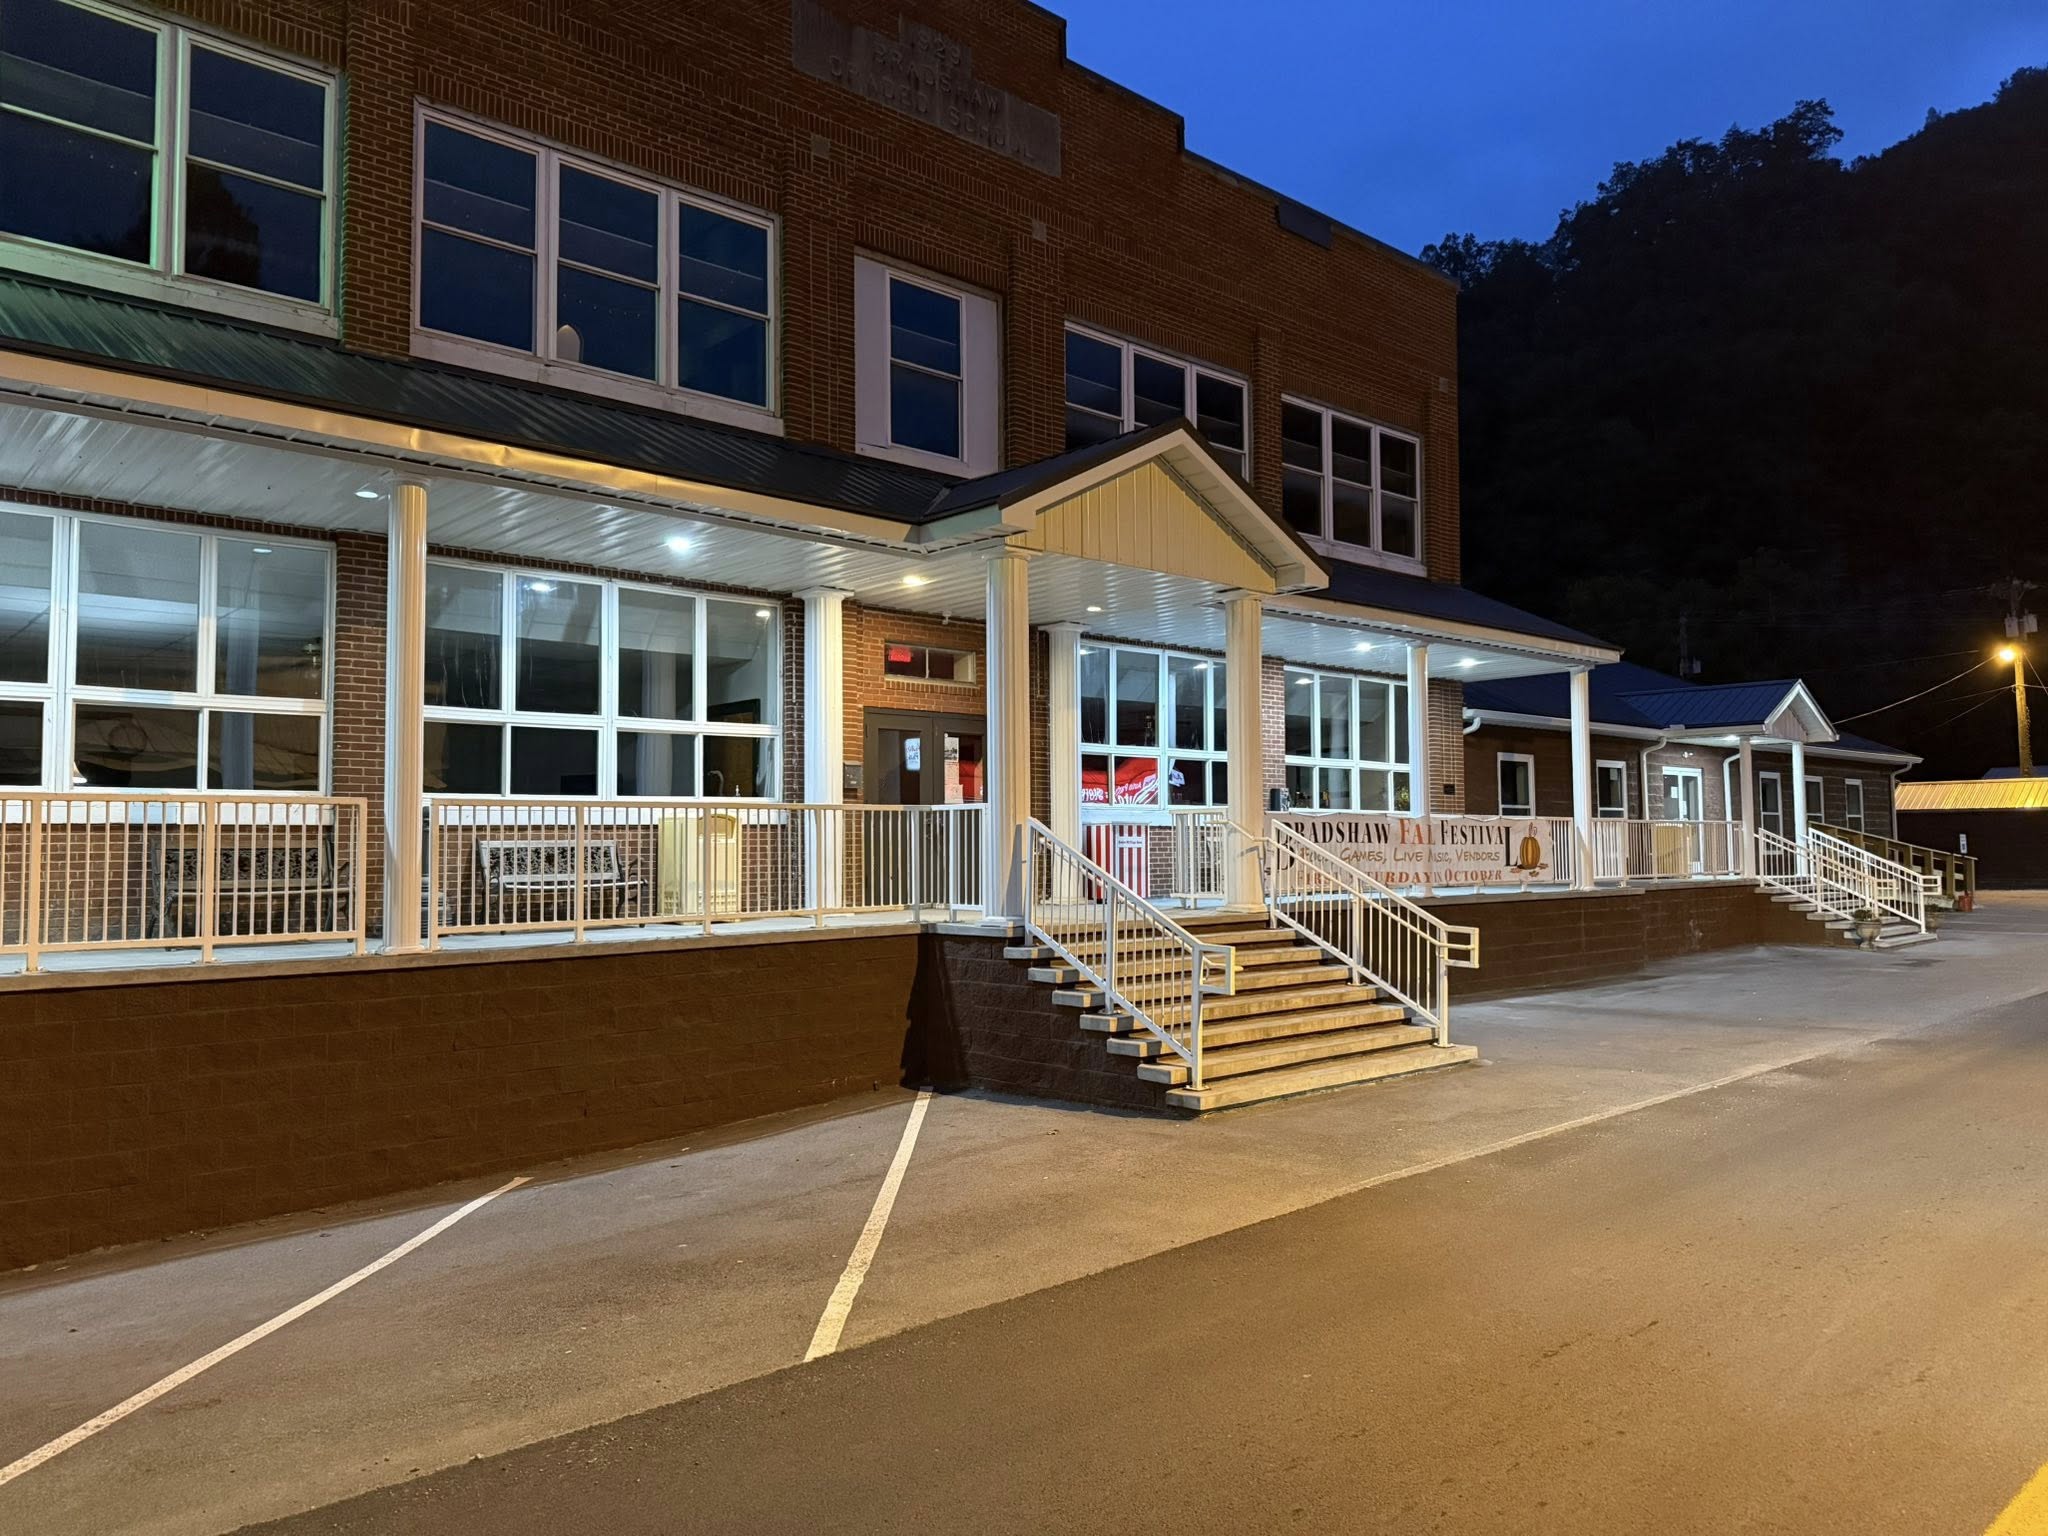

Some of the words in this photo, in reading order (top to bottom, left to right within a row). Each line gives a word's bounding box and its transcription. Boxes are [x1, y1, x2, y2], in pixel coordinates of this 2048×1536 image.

[1393, 847, 1423, 862] LIVE
[1455, 848, 1500, 862] VENDORS
[1444, 864, 1502, 882] OCTOBER
